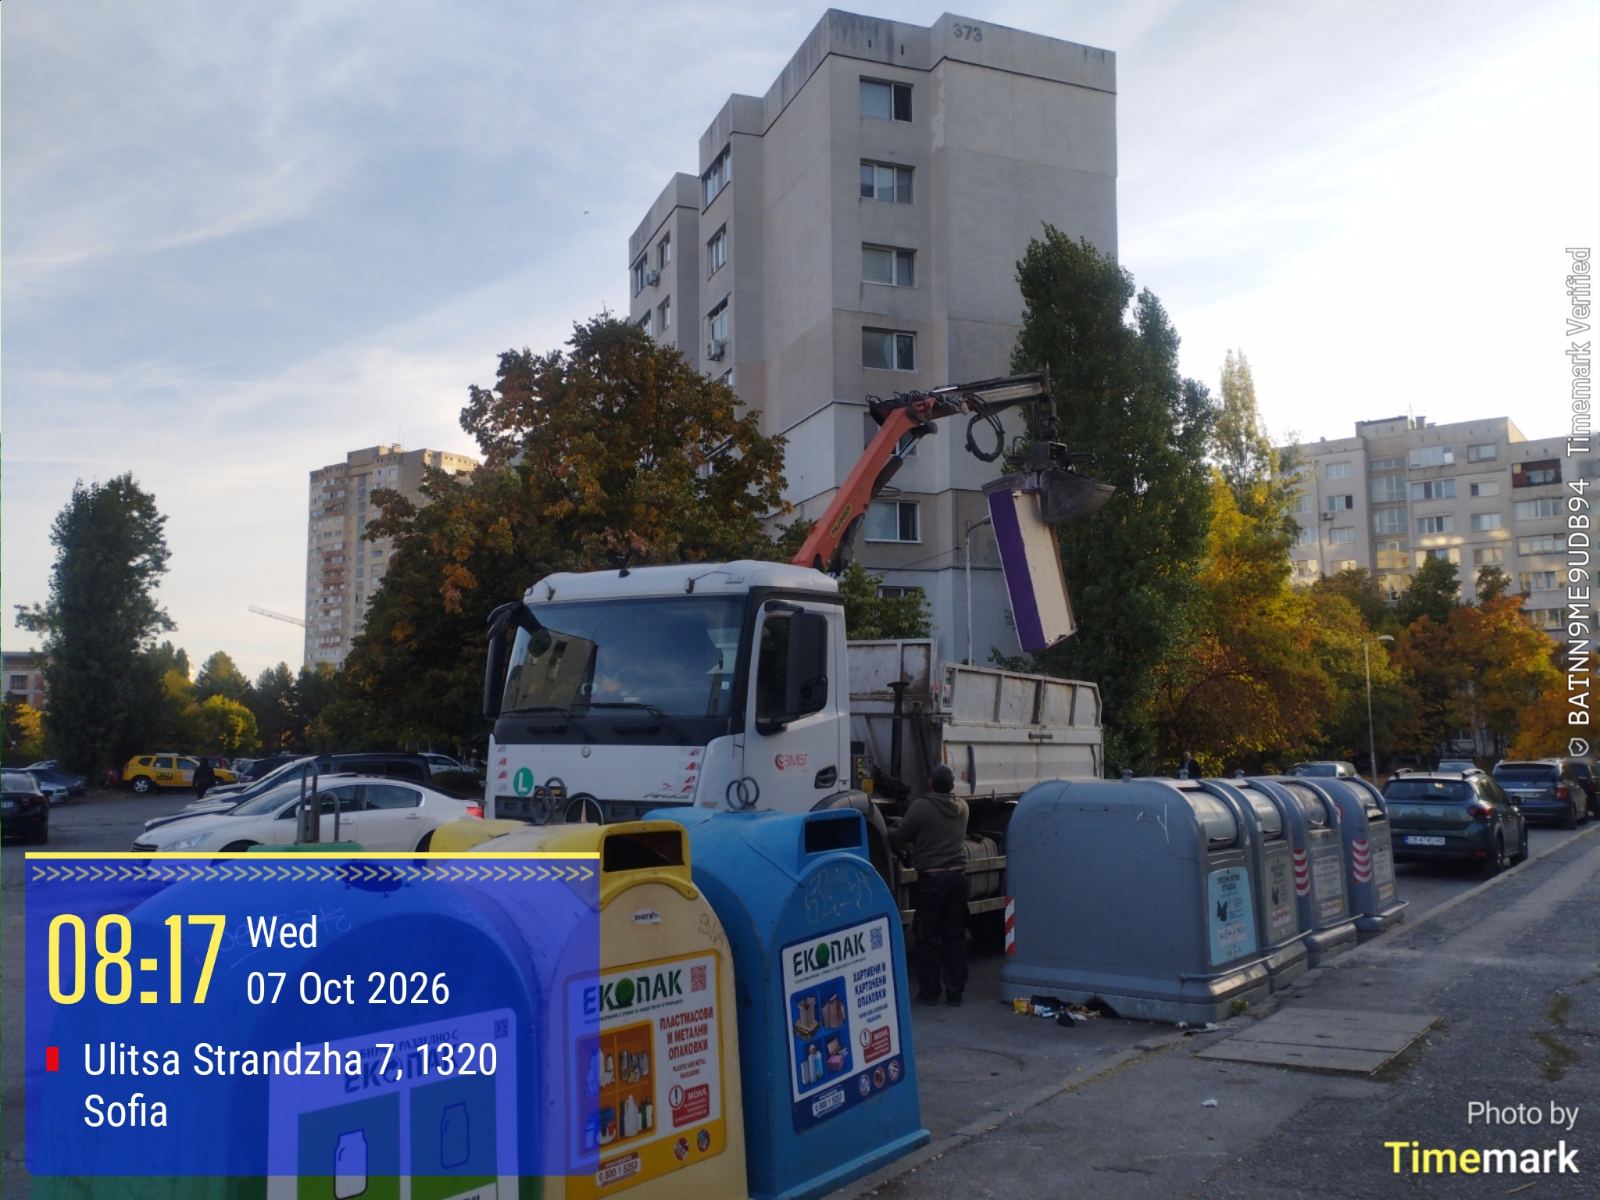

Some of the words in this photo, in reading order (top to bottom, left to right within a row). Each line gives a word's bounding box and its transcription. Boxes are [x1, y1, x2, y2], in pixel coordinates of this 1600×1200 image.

[953, 22, 983, 42] 373
[792, 931, 866, 977] ЕКОПАК
[583, 969, 683, 1016] ЕКОПАК
[854, 975, 887, 995] КАРТОНЕНИ
[659, 1006, 714, 1030] ПЛАСТМАСОВИ
[674, 1024, 708, 1041] МЕТАЛНИ
[668, 1039, 708, 1060] ОПАКОВКИ
